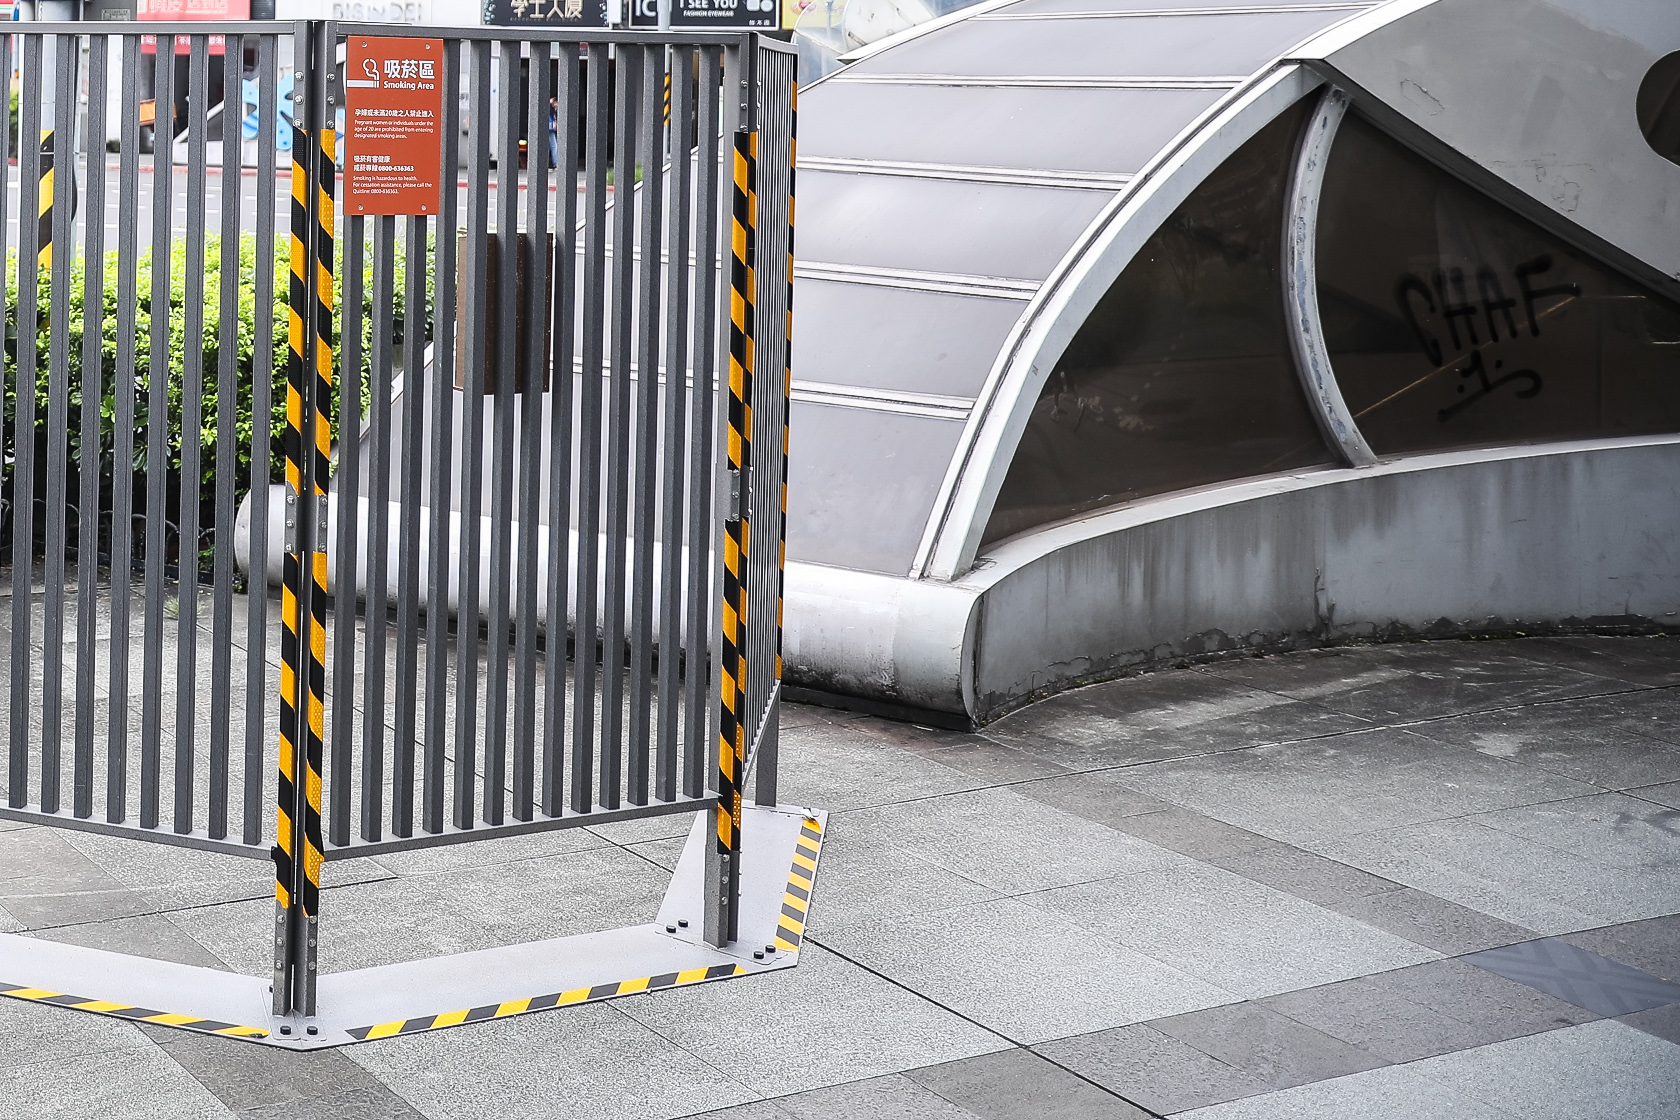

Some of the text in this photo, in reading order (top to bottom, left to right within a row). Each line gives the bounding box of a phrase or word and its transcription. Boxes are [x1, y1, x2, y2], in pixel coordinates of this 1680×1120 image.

[383, 59, 435, 79] 吸菸區
[383, 81, 434, 90] Smoking Area
